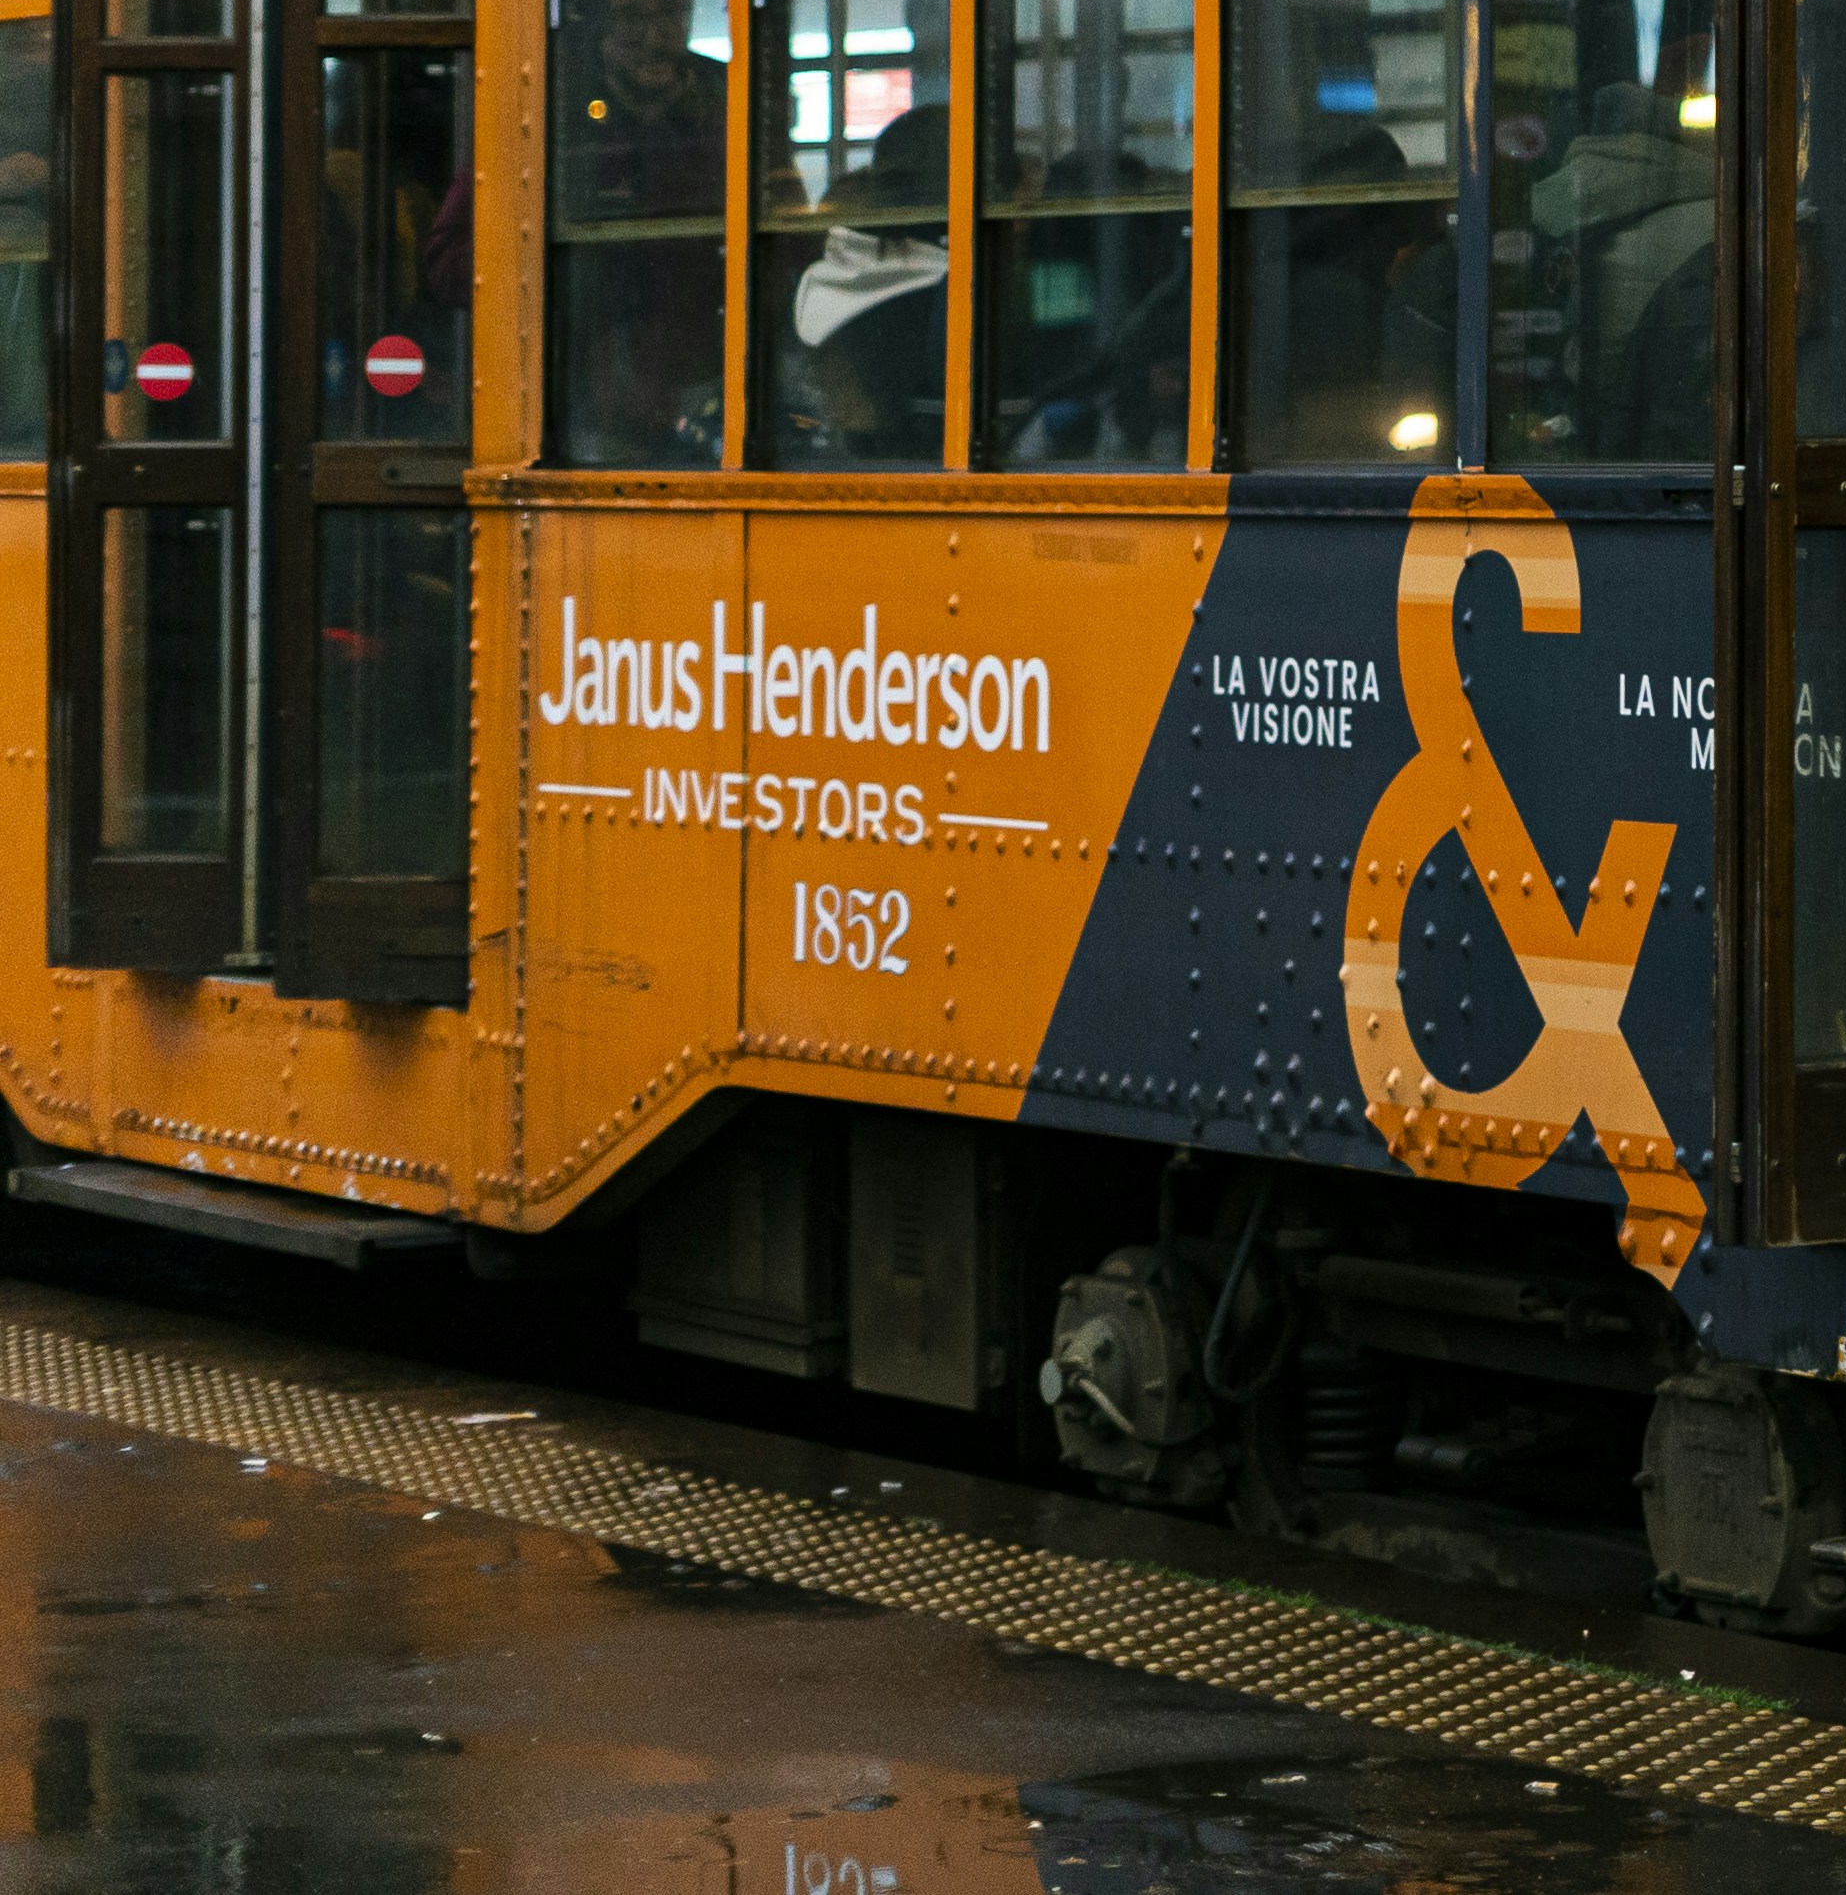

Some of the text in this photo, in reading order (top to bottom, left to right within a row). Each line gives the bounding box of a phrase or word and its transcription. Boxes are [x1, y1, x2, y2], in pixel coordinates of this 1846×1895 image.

[538, 595, 1050, 753] Janus Henderson
[1212, 654, 1381, 704] LA VOSTRA
[1618, 672, 1657, 718] LA
[1230, 701, 1354, 749] VISIONE
[642, 767, 927, 846] INVESTORS
[792, 880, 912, 976] 1852
